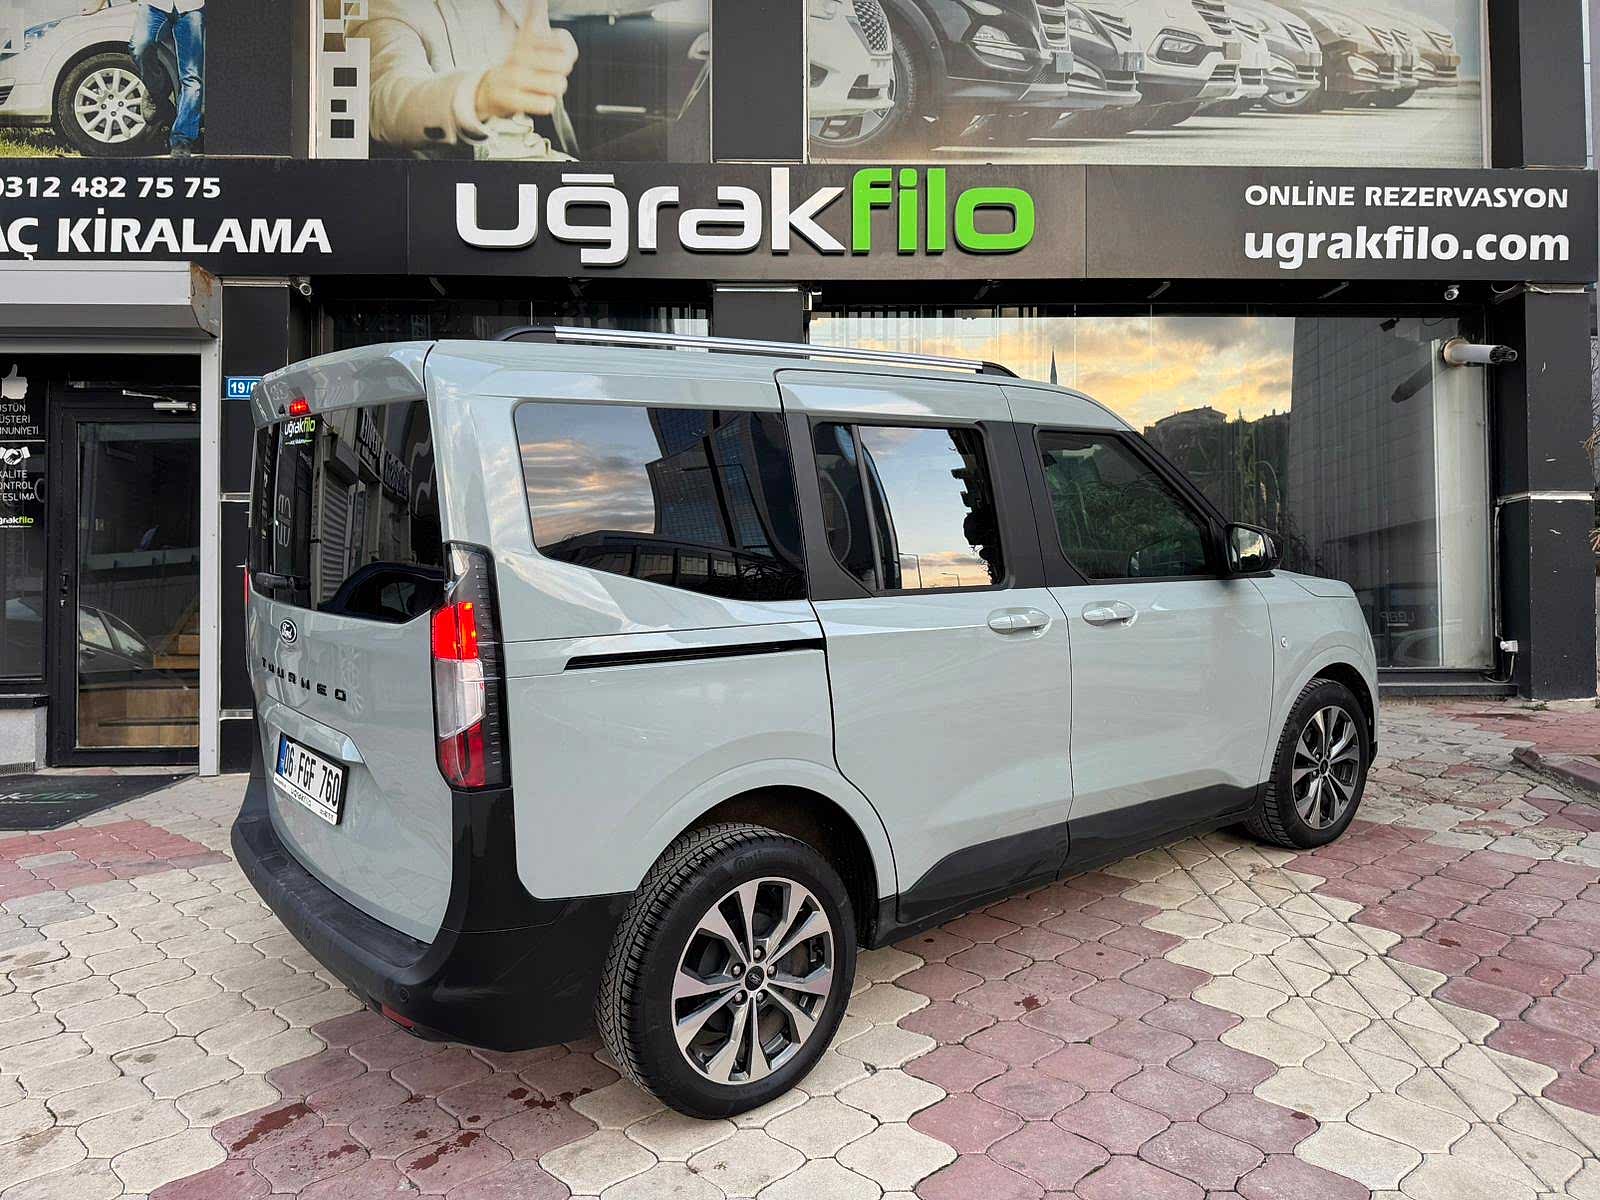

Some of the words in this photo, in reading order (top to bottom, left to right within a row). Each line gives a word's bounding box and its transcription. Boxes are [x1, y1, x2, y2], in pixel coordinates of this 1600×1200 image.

[0, 176, 60, 198] 312
[71, 177, 126, 198] 482
[138, 177, 174, 198] 75
[184, 177, 221, 198] 75
[1245, 180, 1355, 207] ONLİNE
[1365, 186, 1568, 209] REZERVASYON
[0, 217, 39, 261] Ç
[57, 207, 333, 253] KİRALAMA
[1244, 225, 1570, 270] ugrakfilo.com
[0, 402, 26, 413] STÜN
[0, 425, 39, 435] NUNİYETİ
[262, 656, 347, 702] TOURNEO
[297, 752, 317, 791] FGF
[319, 764, 340, 807] 760
